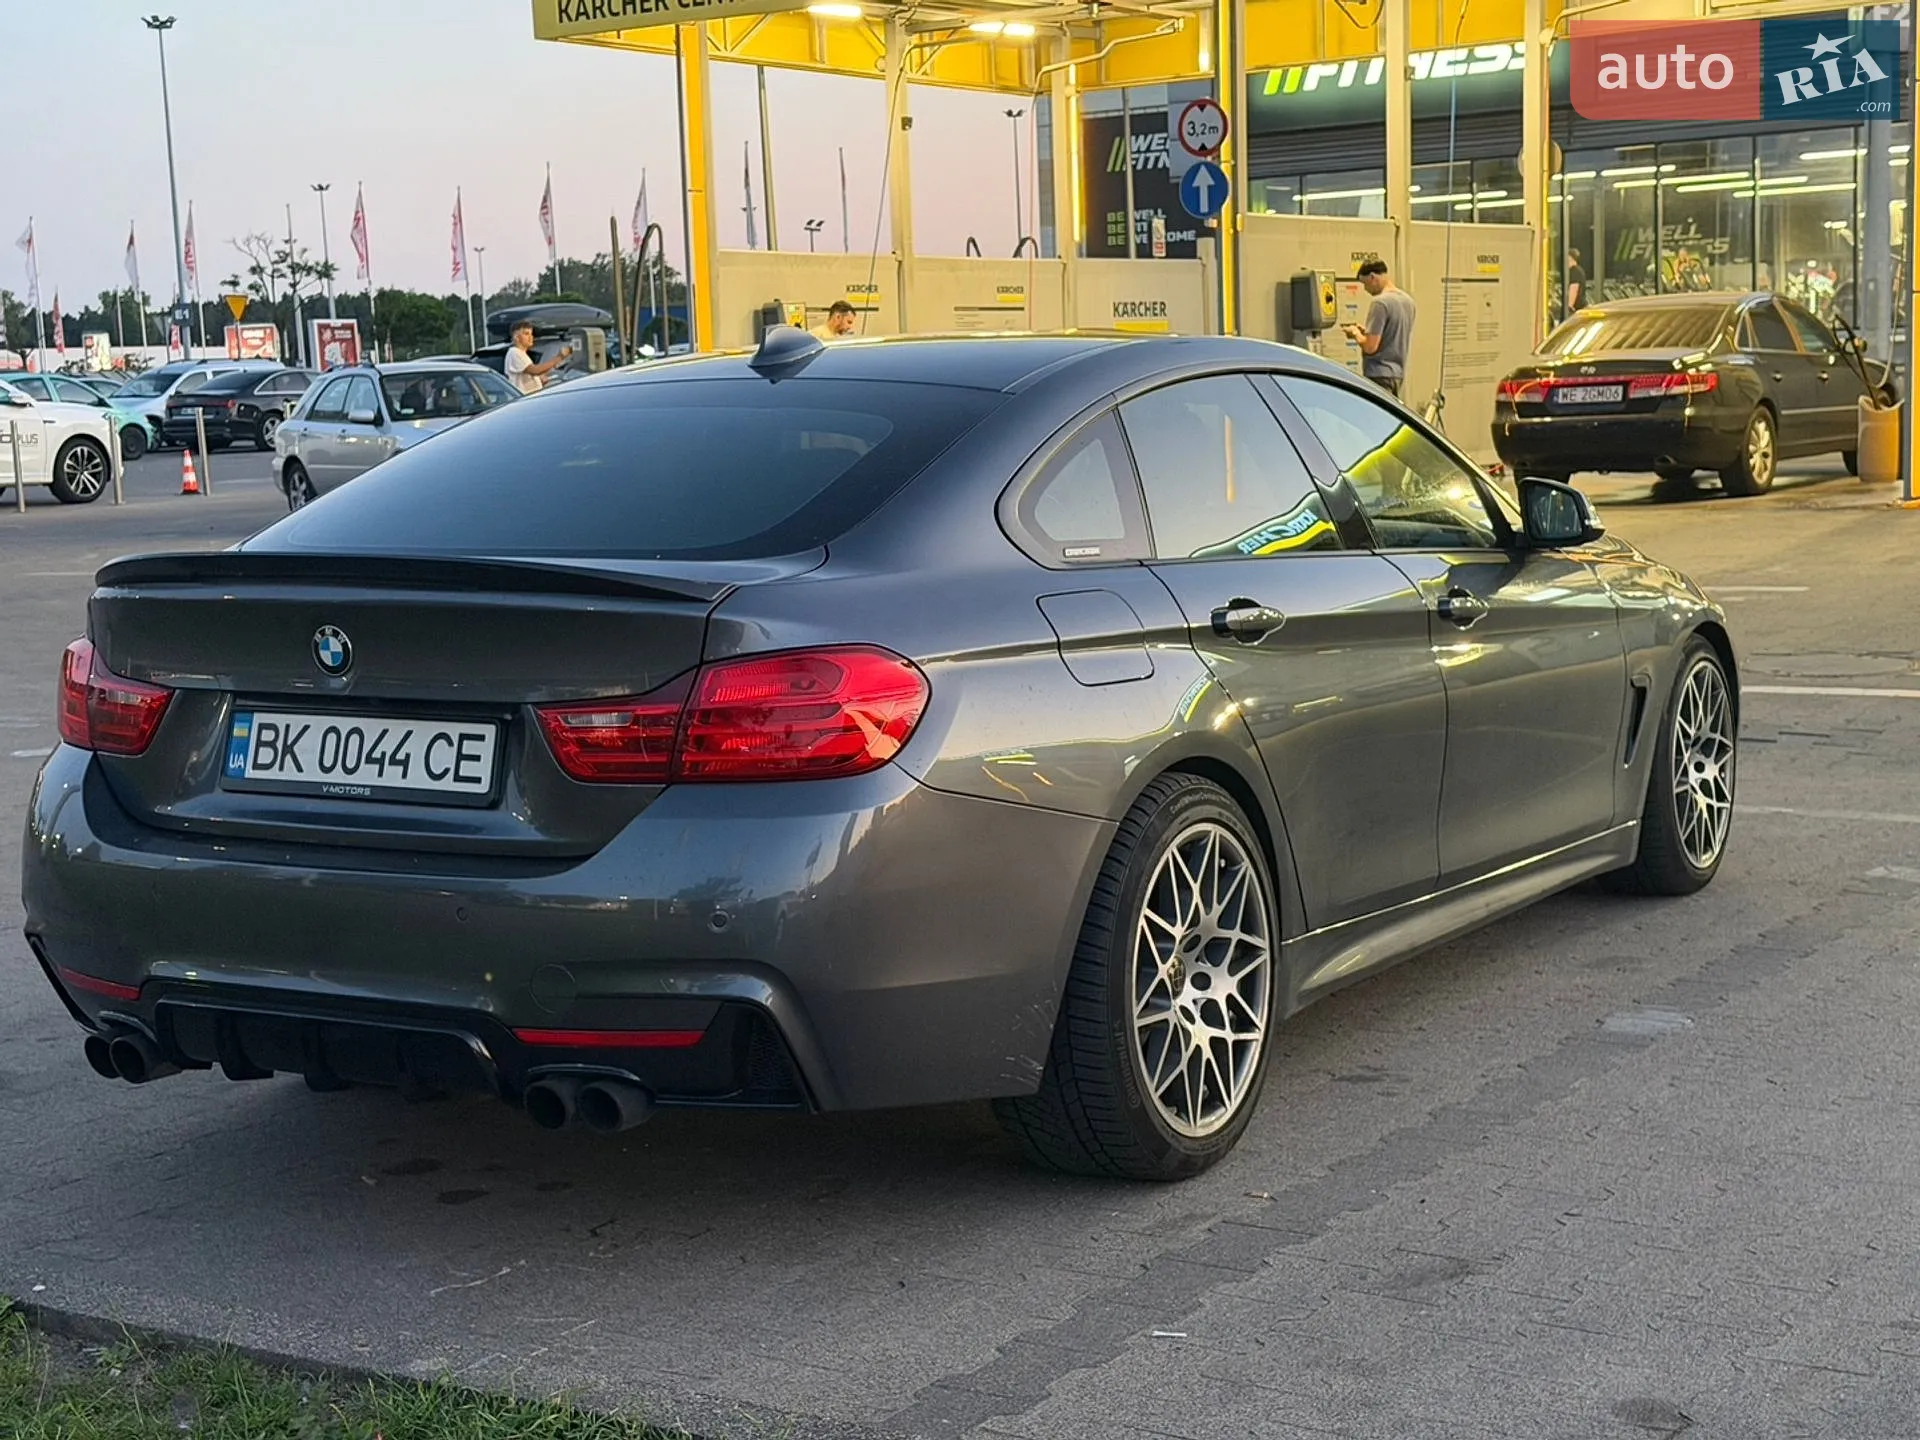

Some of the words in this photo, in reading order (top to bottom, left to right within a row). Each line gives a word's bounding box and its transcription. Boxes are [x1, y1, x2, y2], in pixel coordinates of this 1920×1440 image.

[228, 752, 245, 770] UA
[251, 722, 311, 773] BK
[318, 725, 414, 780] 0044
[424, 731, 486, 785] CE
